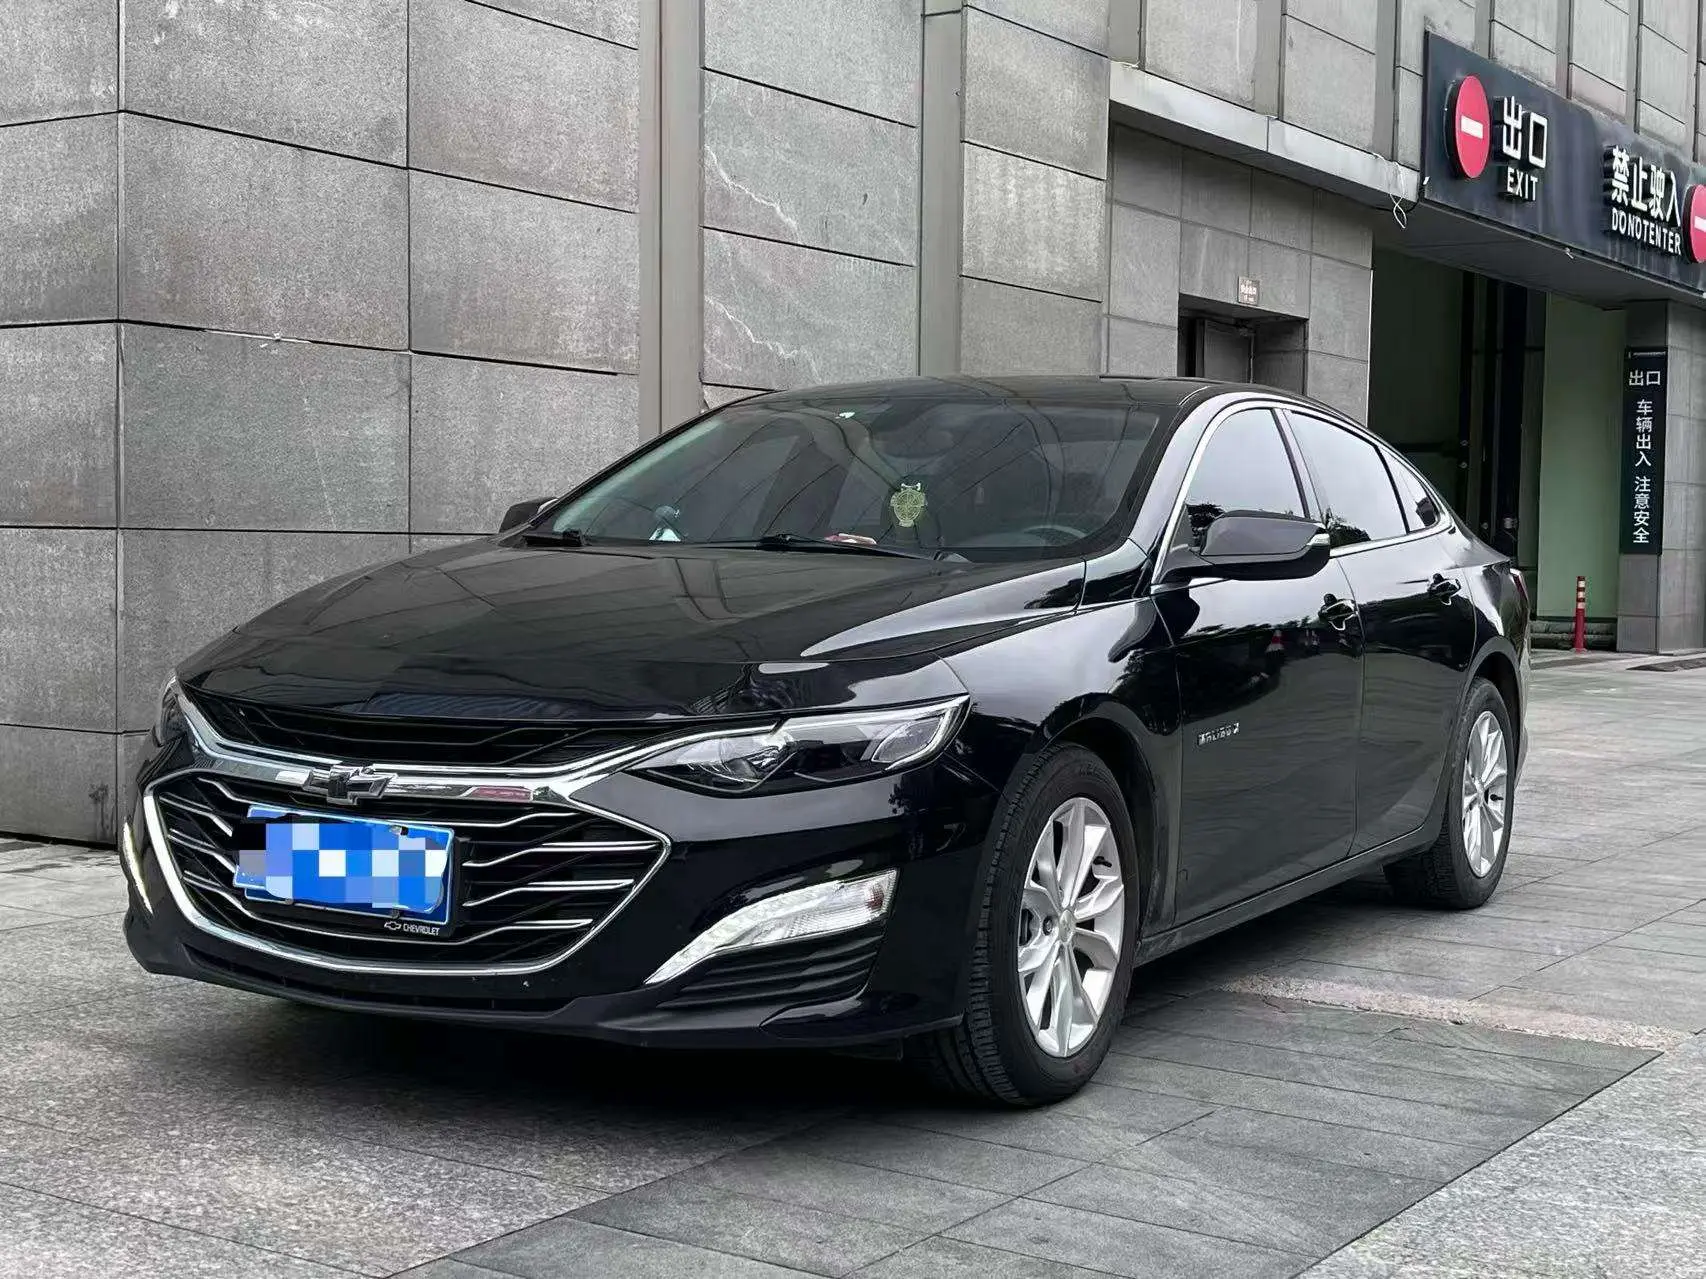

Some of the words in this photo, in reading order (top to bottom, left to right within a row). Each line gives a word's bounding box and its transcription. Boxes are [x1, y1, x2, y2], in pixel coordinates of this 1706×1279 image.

[1503, 96, 1547, 168] 出口
[1507, 166, 1538, 201] EXIT
[1612, 145, 1680, 227] 禁止驶入
[1629, 370, 1660, 386] 出口
[1635, 399, 1653, 467] 车辆出入
[1633, 476, 1651, 544] 注意安全
[403, 923, 440, 936] CHEVROLET
